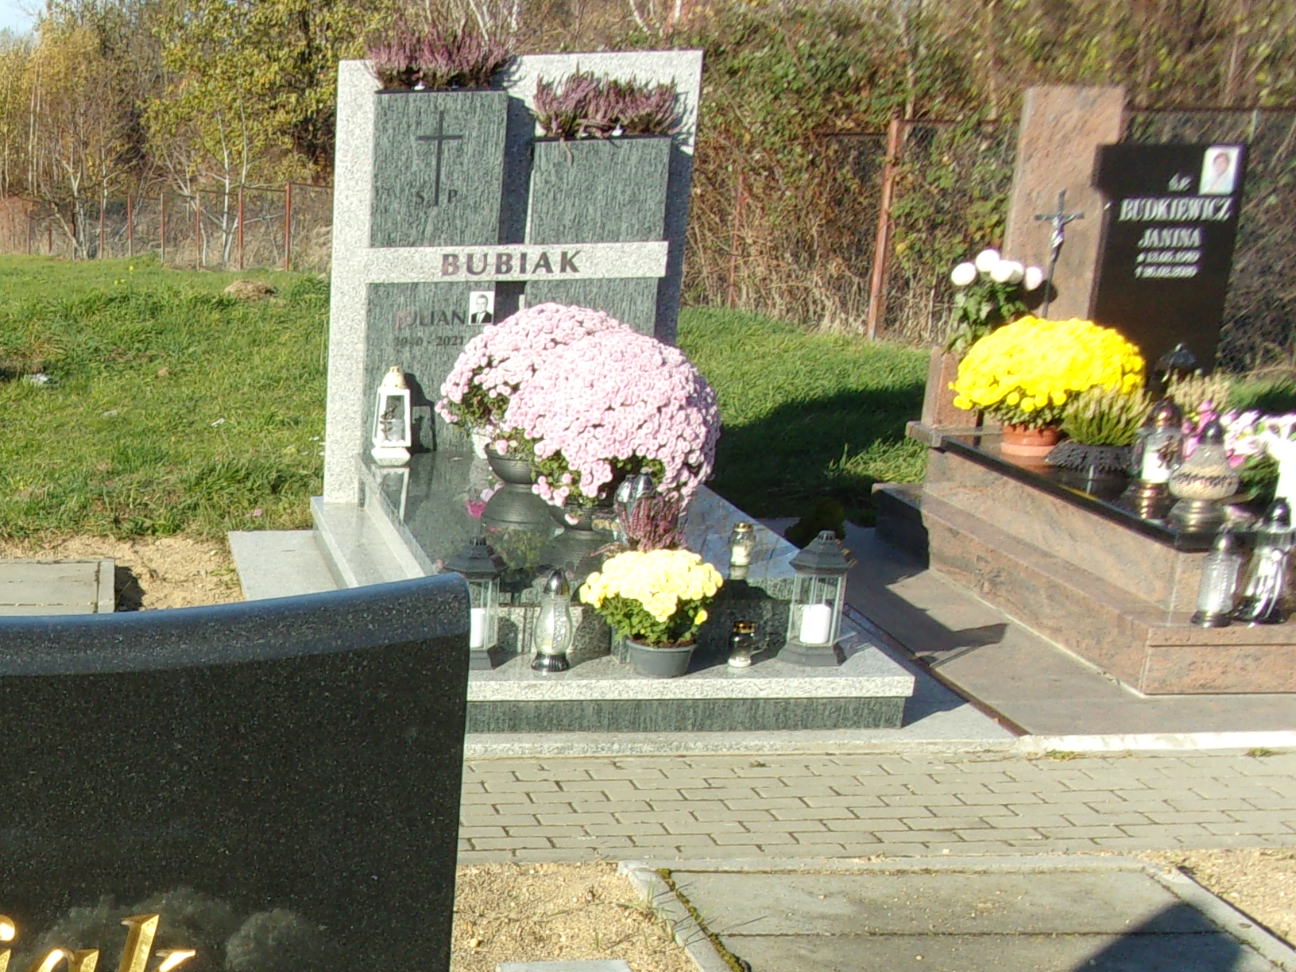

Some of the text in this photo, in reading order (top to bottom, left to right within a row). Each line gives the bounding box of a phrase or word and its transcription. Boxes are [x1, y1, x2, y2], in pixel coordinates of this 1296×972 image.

[1119, 197, 1232, 222] BUDKIEWICZ
[1138, 227, 1201, 248] JANINA
[441, 250, 582, 276] BUBIAK
